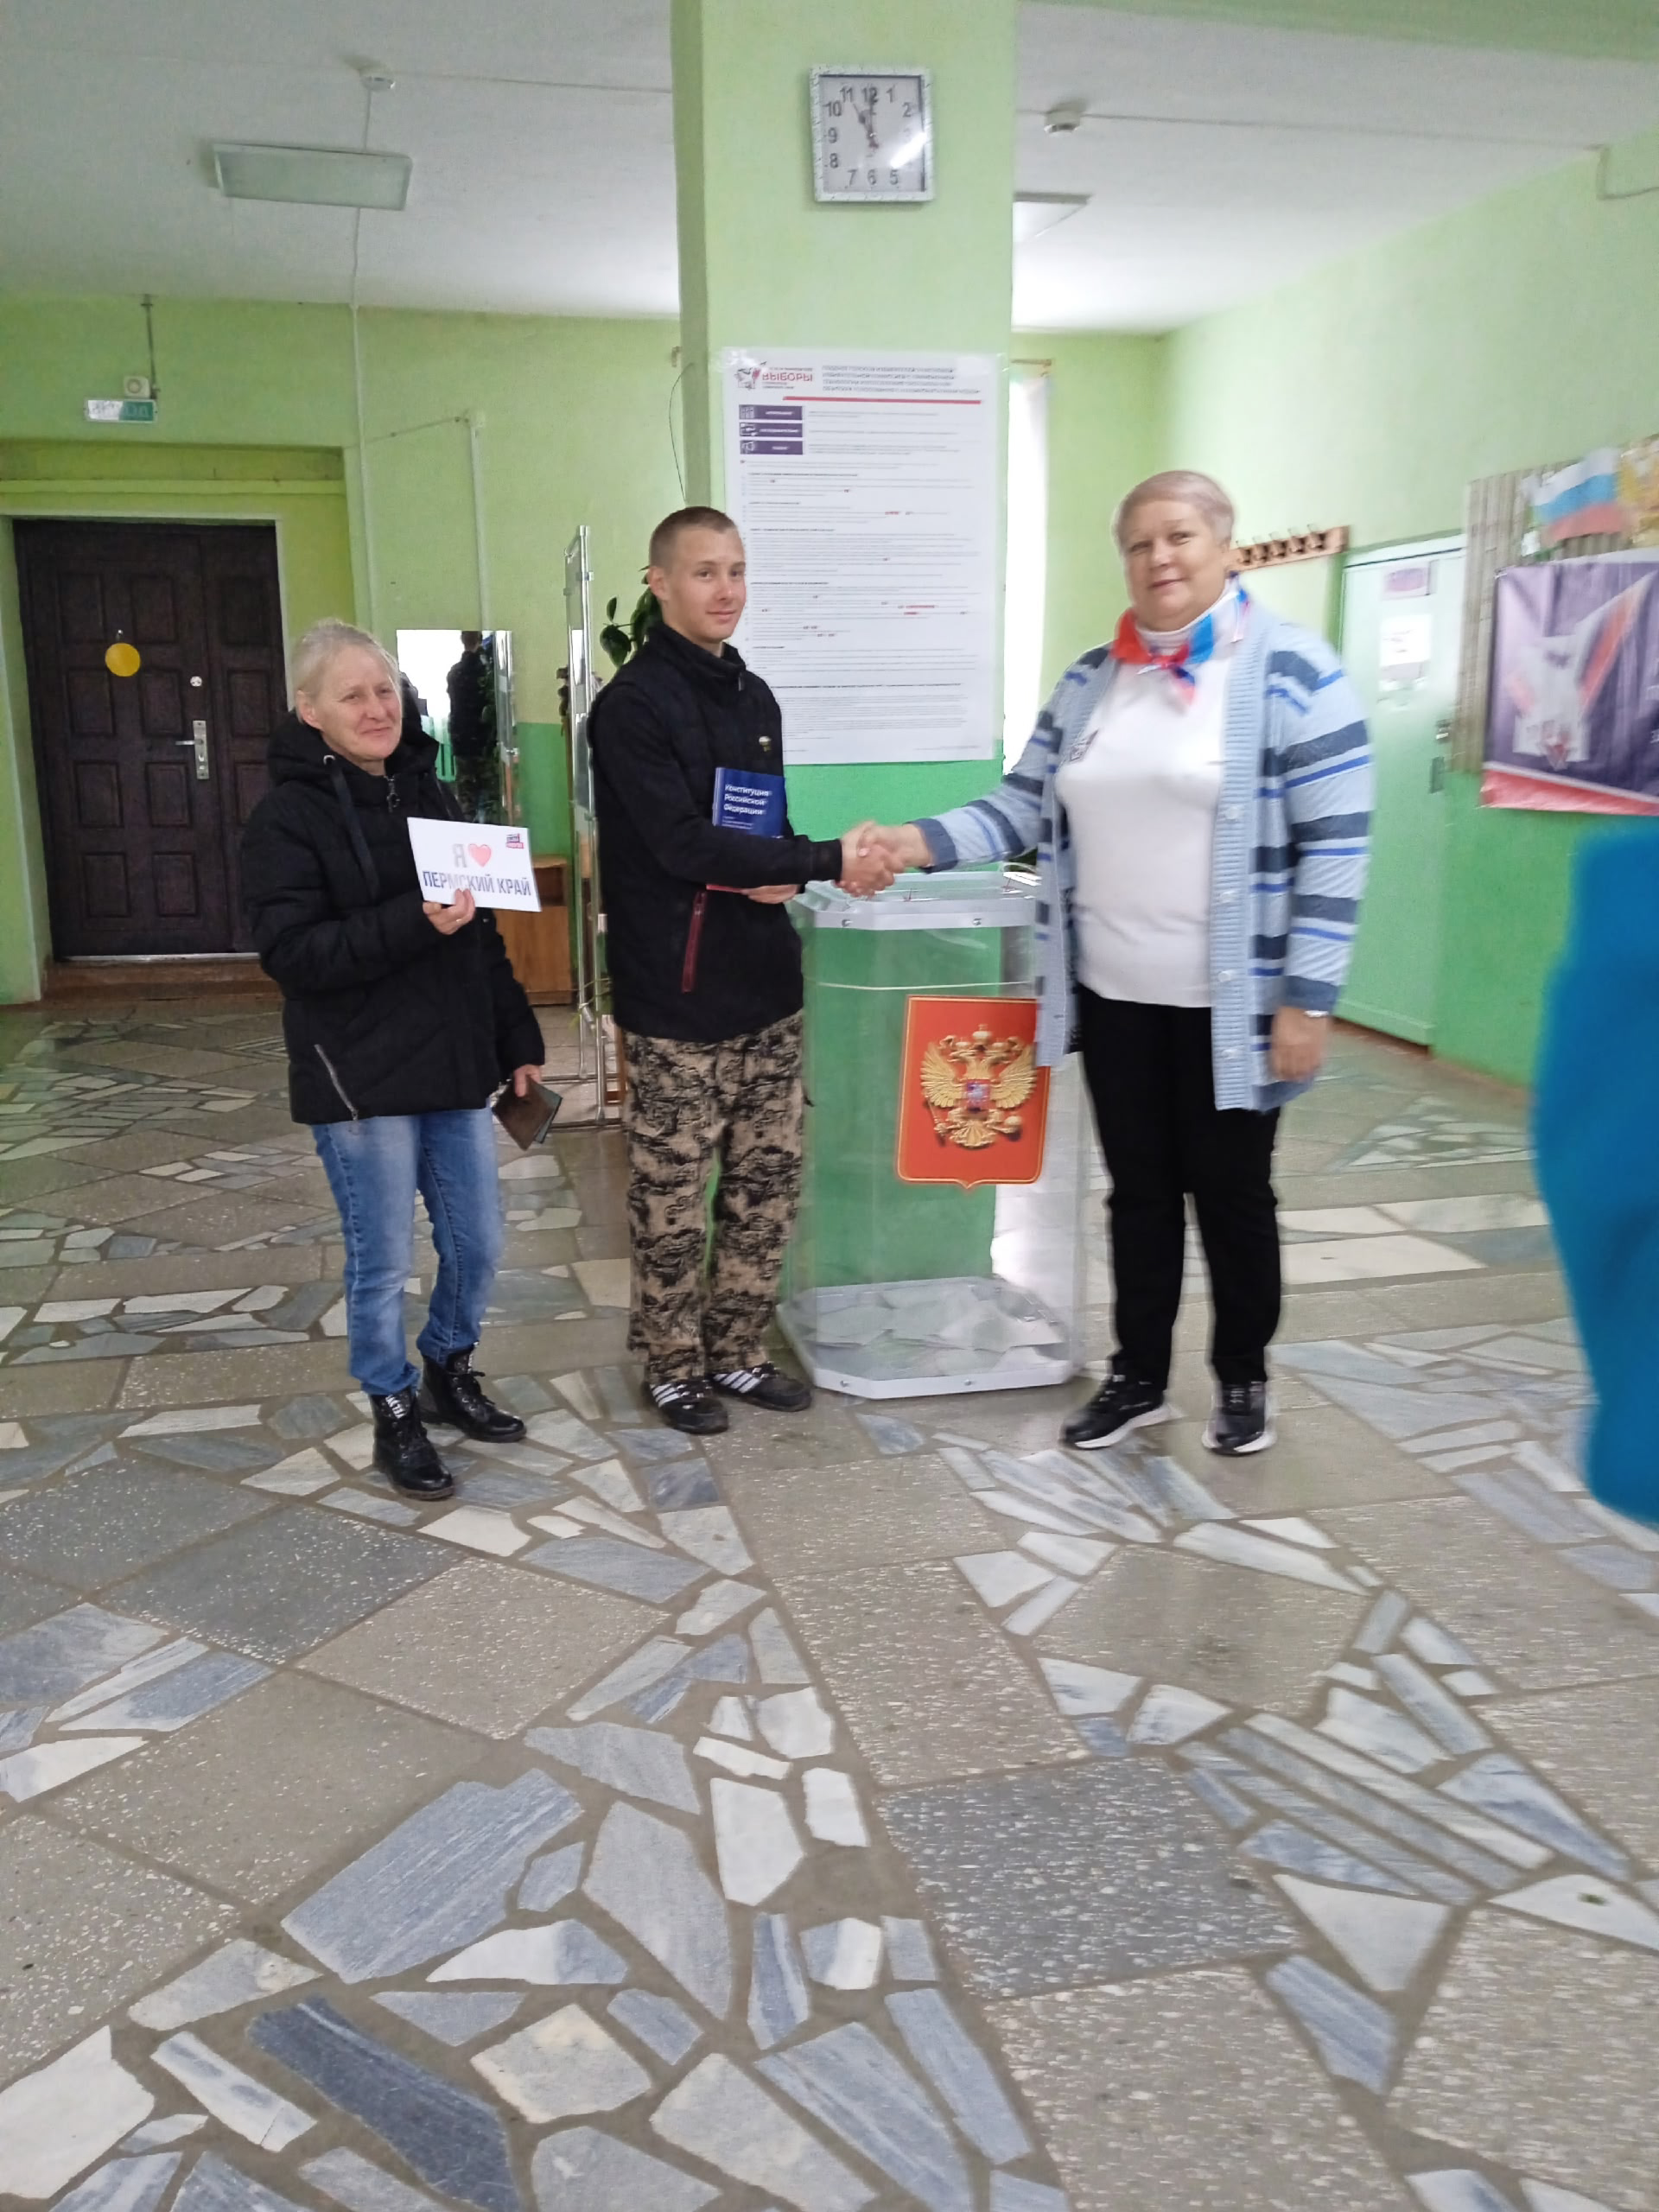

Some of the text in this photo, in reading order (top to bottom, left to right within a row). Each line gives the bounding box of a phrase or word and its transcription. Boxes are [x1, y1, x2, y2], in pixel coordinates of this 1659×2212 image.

[840, 87, 854, 103] 11
[861, 87, 878, 104] 12
[887, 87, 894, 103] 1
[825, 100, 842, 117] 10
[902, 102, 912, 118] 2
[827, 127, 838, 143] 9
[829, 153, 839, 168] 8
[848, 169, 857, 186] 7
[867, 169, 877, 185] 6
[889, 169, 899, 185] 5
[761, 372, 813, 382] ВЫБОРЫ
[724, 784, 771, 797] Конституция
[724, 793, 766, 806] Российской
[723, 803, 765, 816] Федерации
[452, 843, 467, 868] Я
[423, 871, 531, 897] ПЕРМСКИЙ КРАЙ
